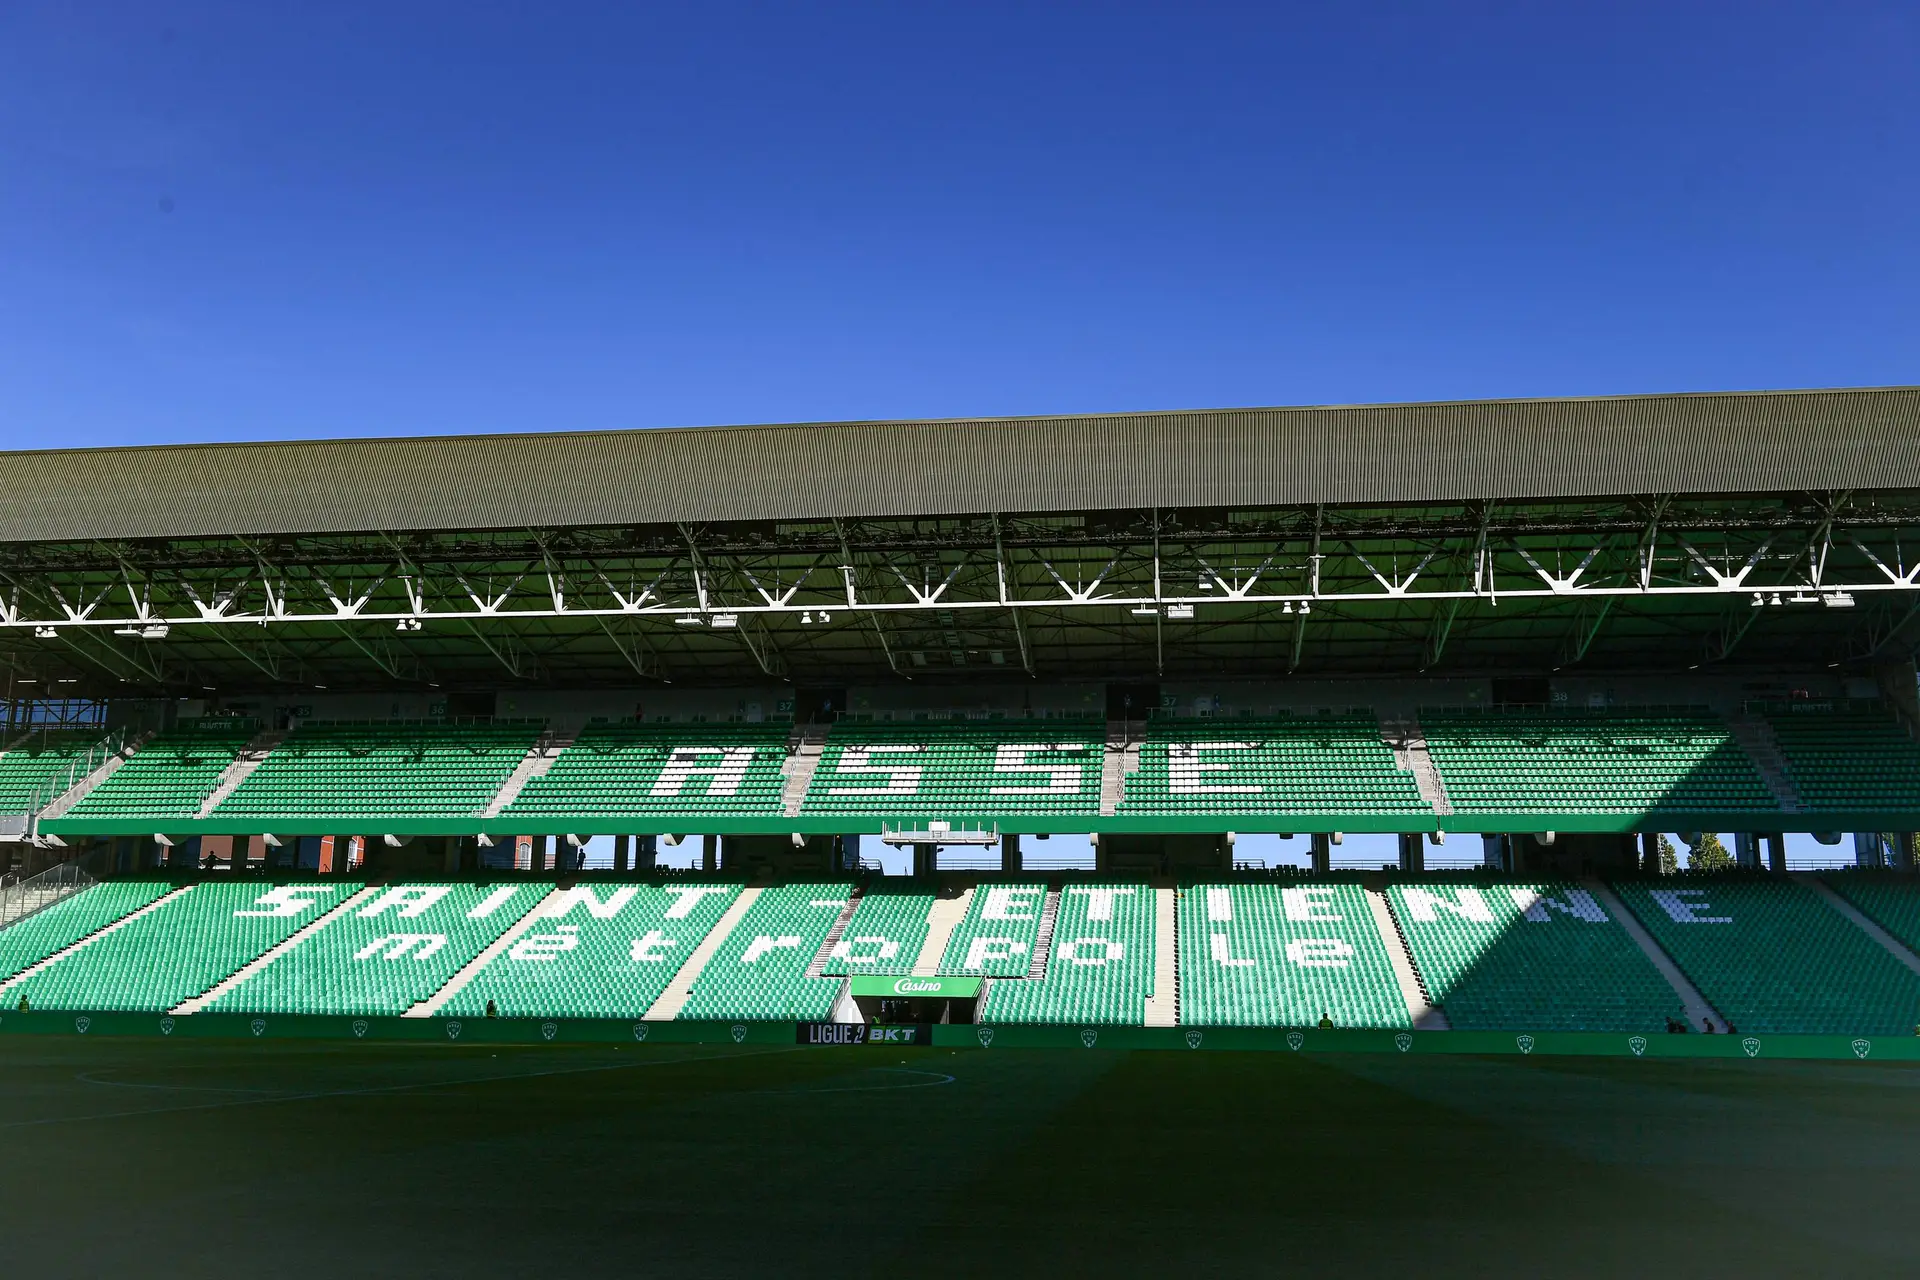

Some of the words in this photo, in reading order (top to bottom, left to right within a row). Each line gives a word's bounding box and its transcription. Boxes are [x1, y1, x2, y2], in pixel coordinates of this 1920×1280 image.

[779, 701, 792, 711] 37
[1164, 696, 1176, 706] 37
[431, 705, 444, 715] 36
[650, 743, 1263, 796] ASSE
[894, 978, 942, 995] Casino
[809, 1024, 851, 1044] LIGUE
[854, 1025, 866, 1044] 2
[869, 1026, 915, 1041] BKT
